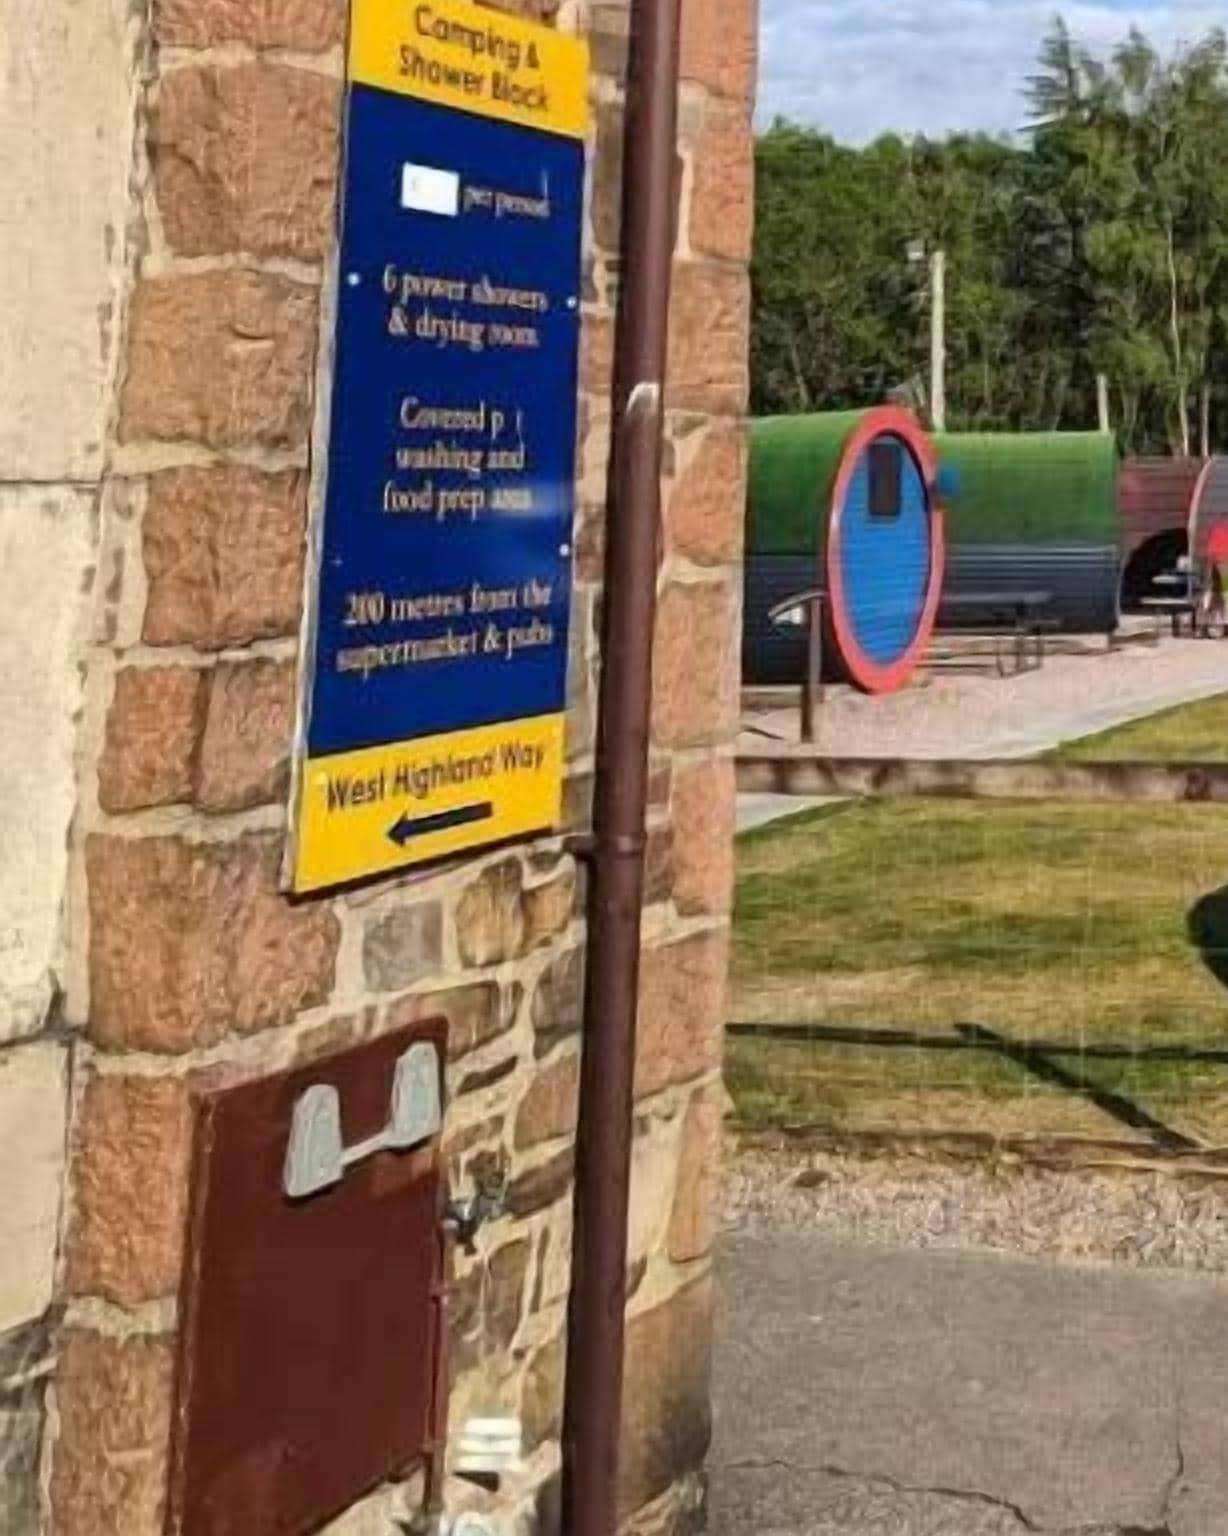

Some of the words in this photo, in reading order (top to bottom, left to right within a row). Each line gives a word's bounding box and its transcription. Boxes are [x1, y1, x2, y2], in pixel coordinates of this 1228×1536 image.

[415, 4, 521, 70] Camping
[526, 41, 541, 70] &
[399, 43, 485, 95] Shower
[491, 70, 549, 113] Block
[388, 305, 408, 337] &
[415, 307, 484, 352] drying
[400, 395, 486, 432] Covered
[396, 440, 481, 480] washing
[487, 438, 526, 469] and
[384, 479, 433, 513] food
[437, 486, 486, 522] prep
[483, 621, 501, 654] &
[326, 766, 386, 812] West
[391, 744, 493, 800] Highland
[499, 736, 546, 773] Way
